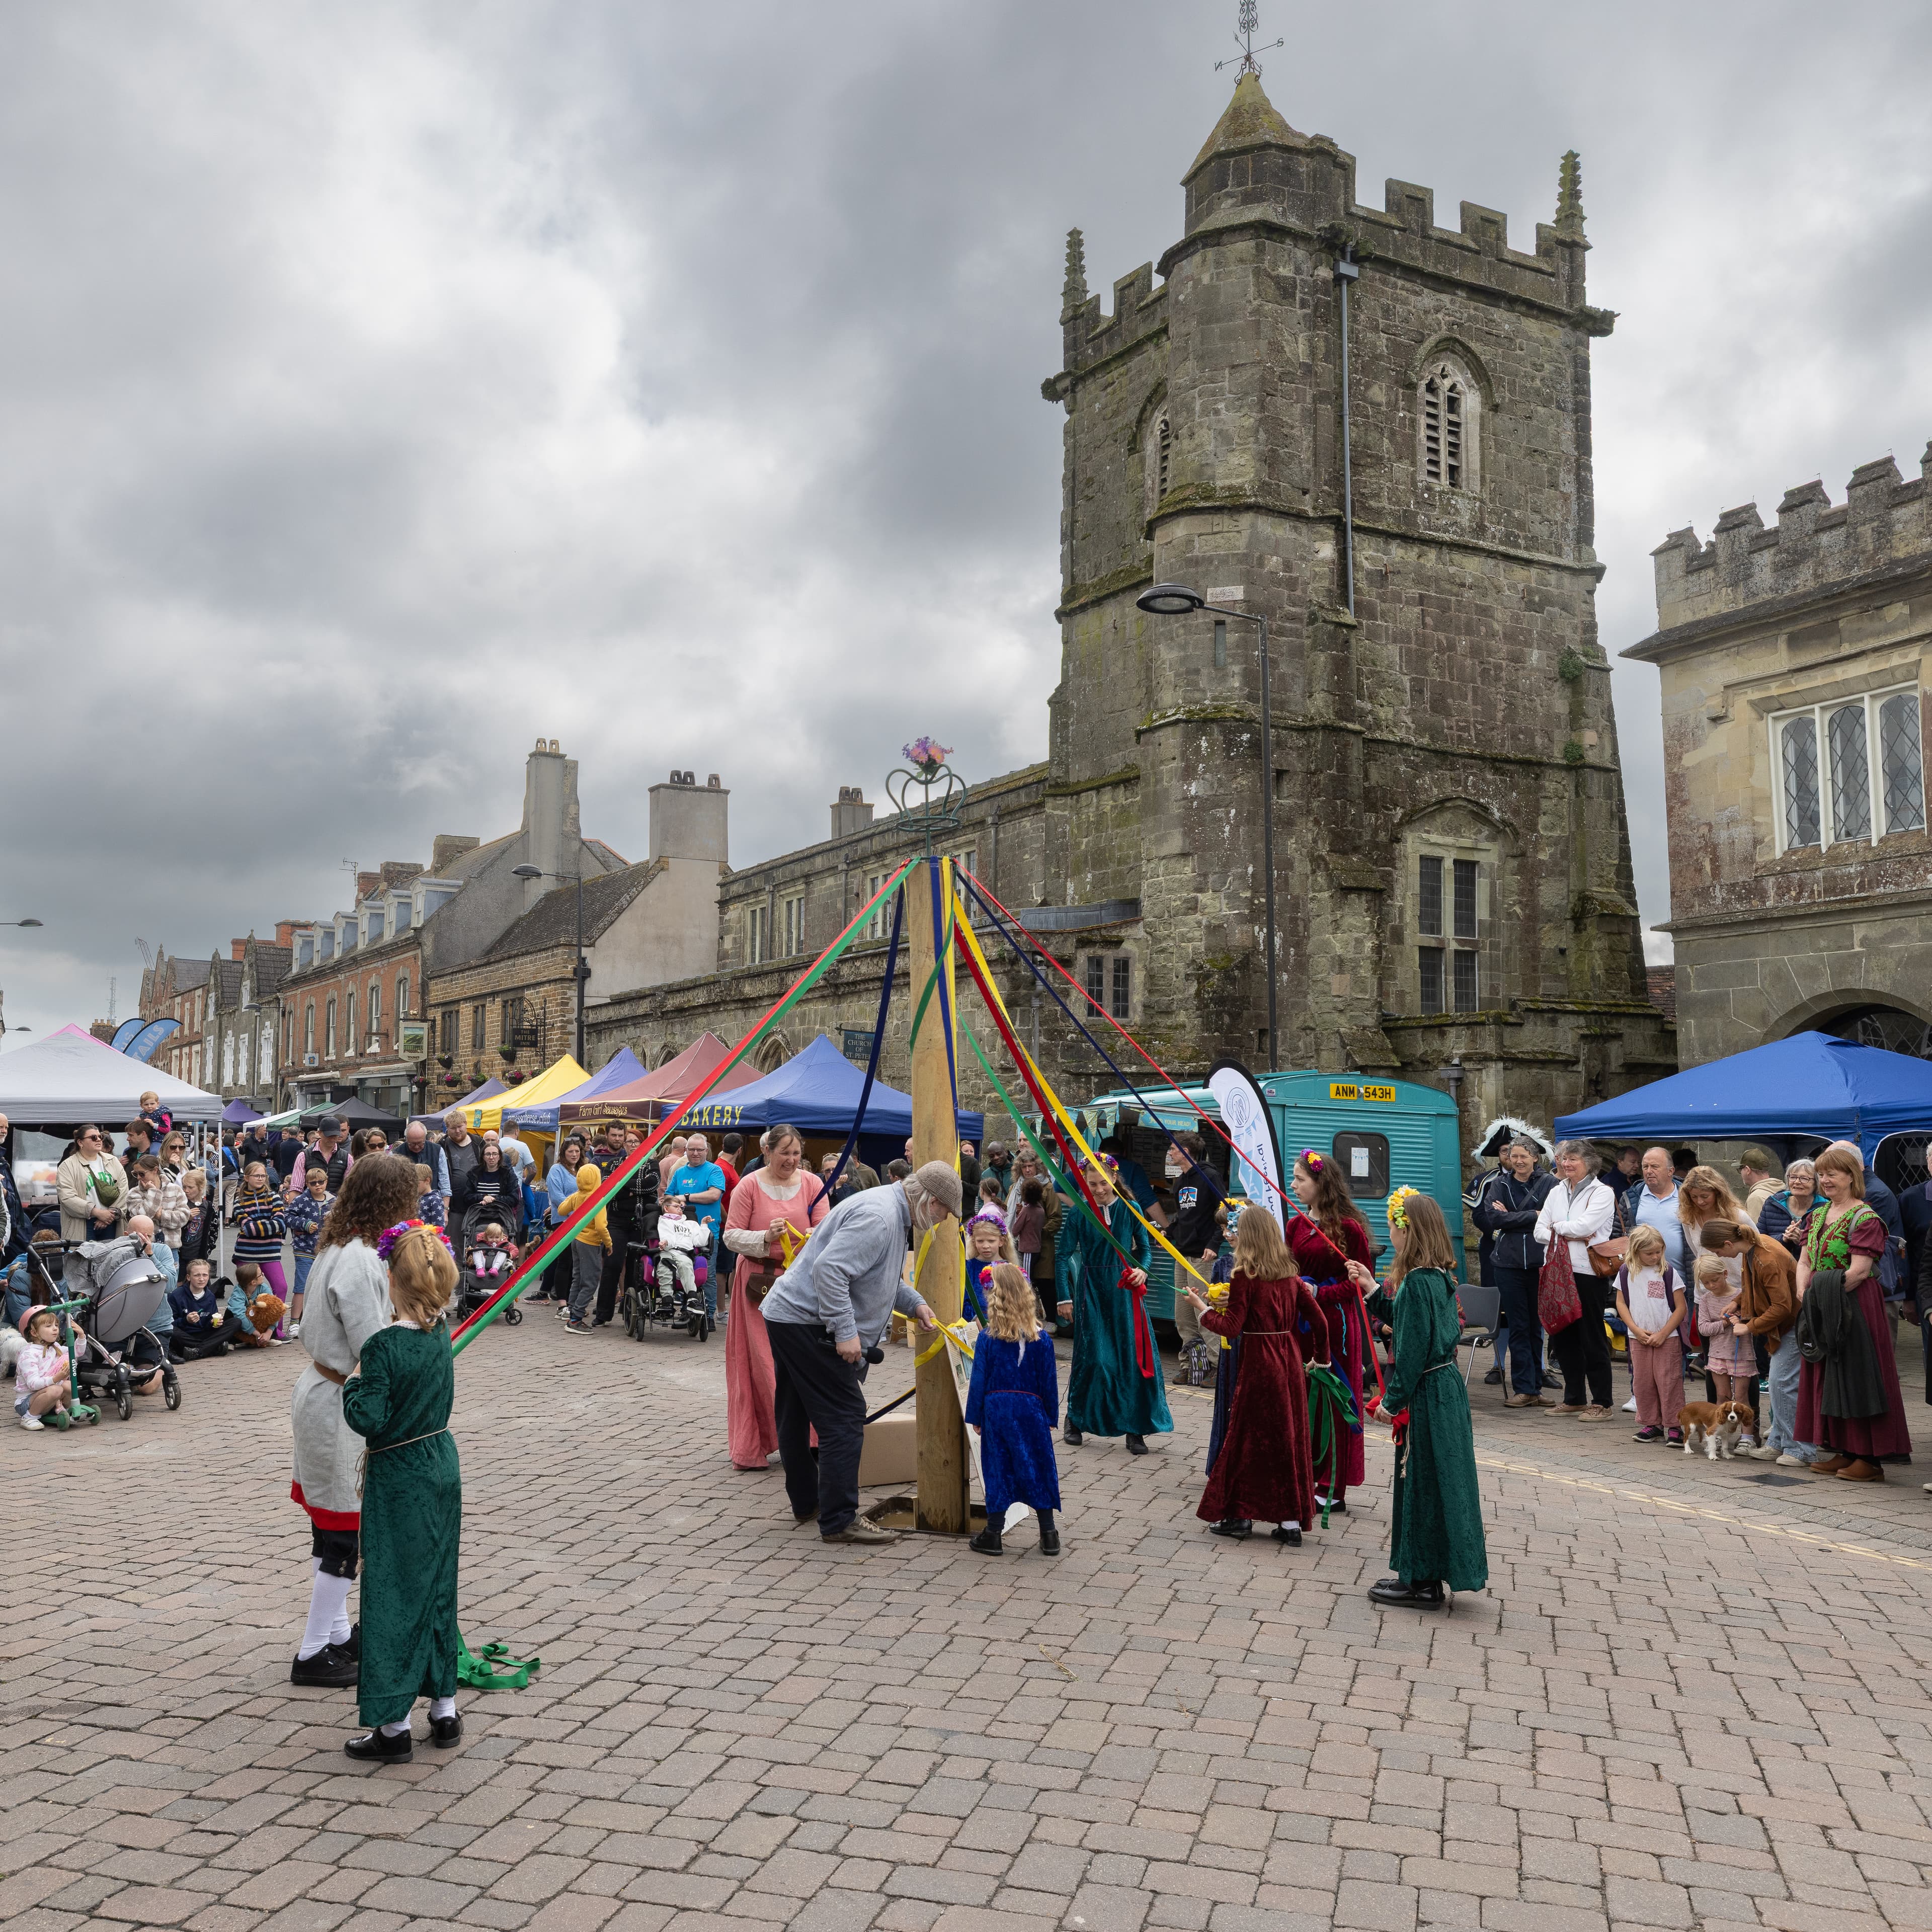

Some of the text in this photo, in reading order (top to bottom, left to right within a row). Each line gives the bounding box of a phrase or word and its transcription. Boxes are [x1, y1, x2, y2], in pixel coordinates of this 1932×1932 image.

[1335, 1086, 1391, 1099] ANM 543H
[579, 1102, 627, 1117] Farm Girl Sausages
